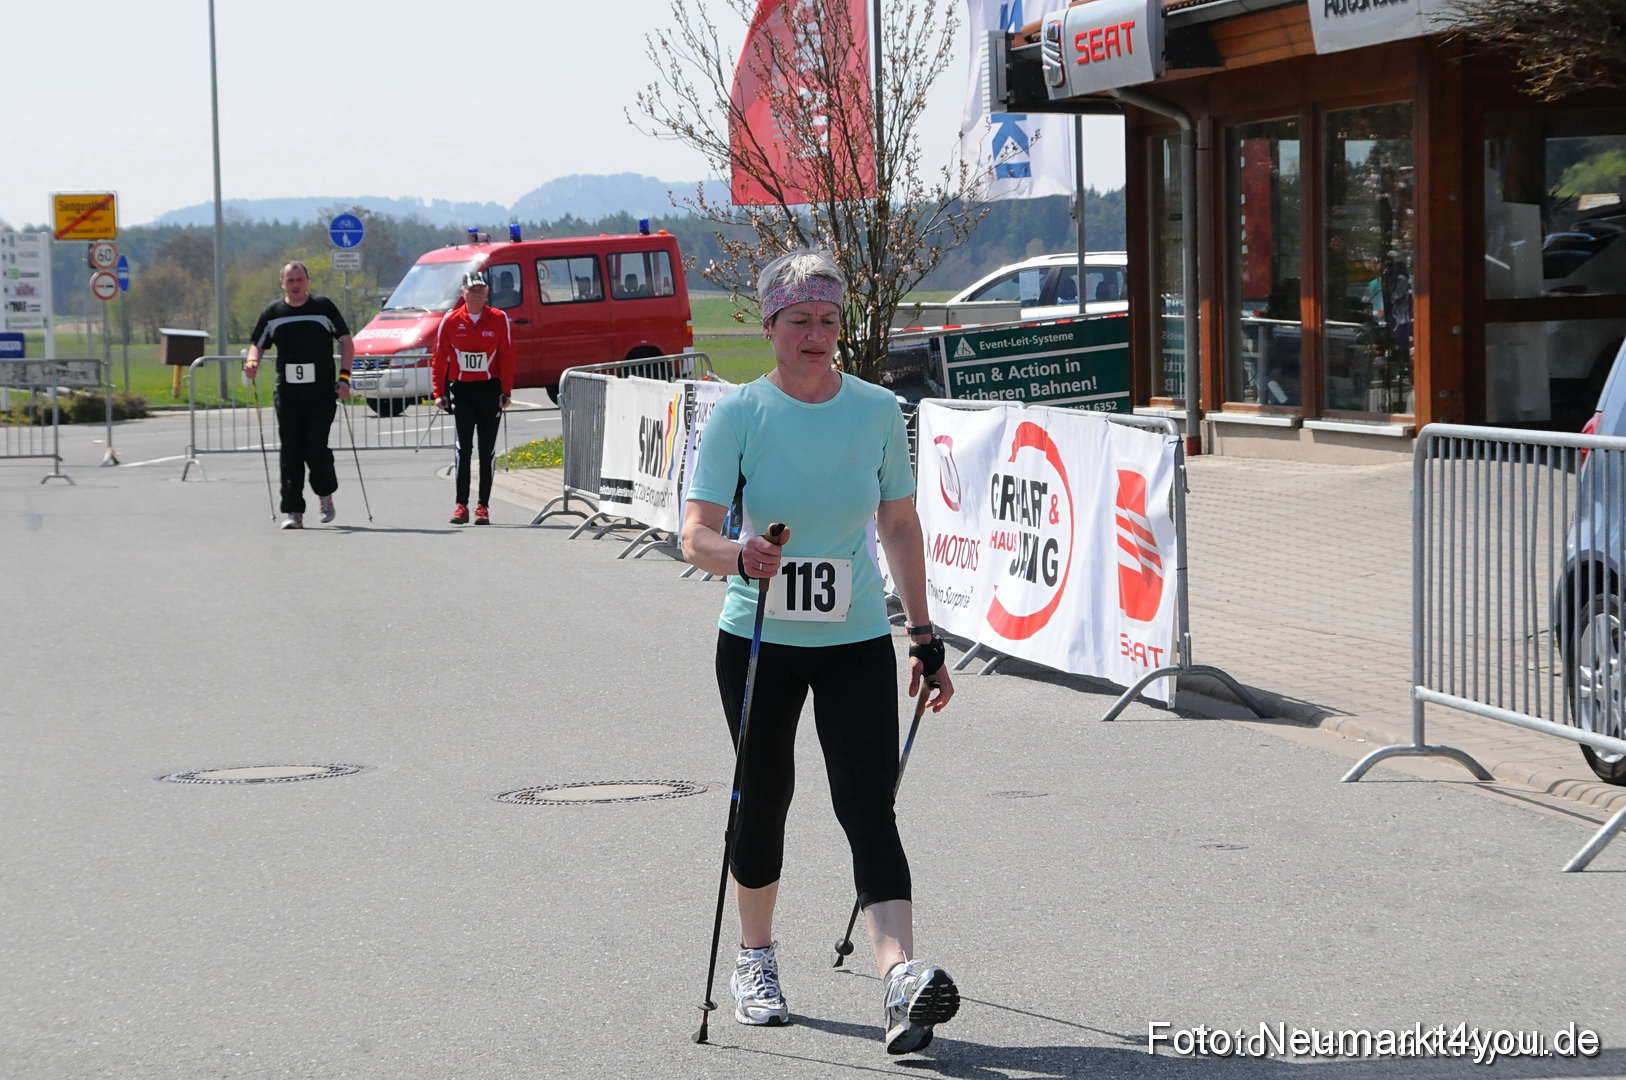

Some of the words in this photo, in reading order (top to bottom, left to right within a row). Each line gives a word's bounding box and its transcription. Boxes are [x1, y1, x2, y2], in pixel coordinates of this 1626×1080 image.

[1074, 20, 1136, 65] SEAT
[97, 248, 113, 262] 60
[979, 332, 1074, 350] Event-Leit-Systeme
[296, 365, 304, 380] 9
[464, 353, 484, 370] 107
[956, 371, 986, 386] Fun
[991, 367, 1004, 381] &
[1008, 361, 1061, 380] Action
[1065, 358, 1081, 373] in
[1030, 376, 1098, 398] Bahnen!
[1094, 401, 1118, 412] 6352
[1049, 493, 1060, 525] &
[989, 530, 1017, 552] HAUS
[932, 533, 980, 572] MOTORS
[781, 562, 836, 612] 113
